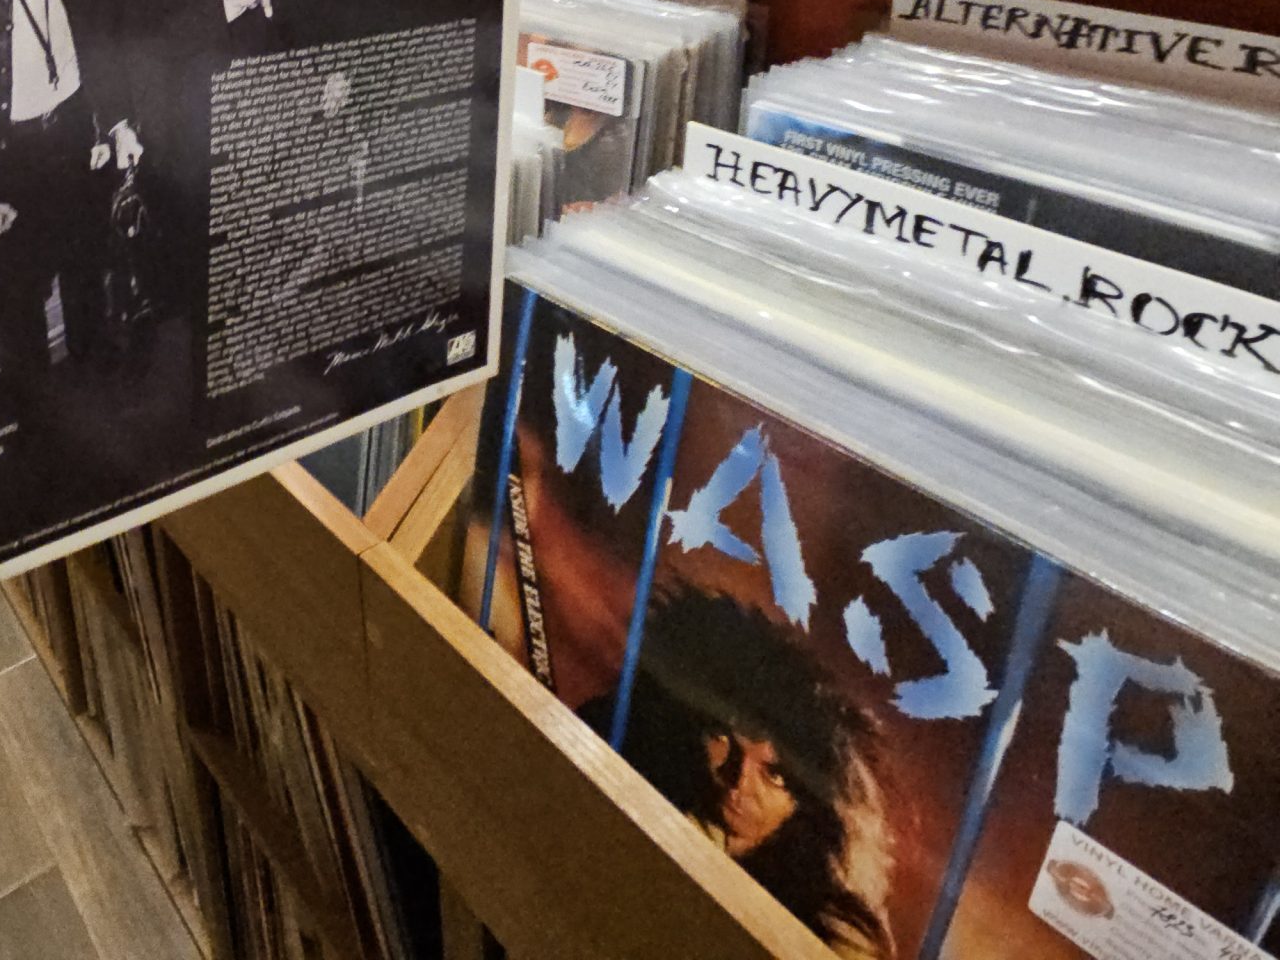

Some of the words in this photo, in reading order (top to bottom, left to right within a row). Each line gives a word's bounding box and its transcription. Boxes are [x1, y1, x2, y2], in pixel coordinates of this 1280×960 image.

[782, 129, 824, 155] FIRST
[826, 141, 868, 166] VINYL
[870, 154, 953, 195] PRESSING
[952, 181, 1001, 208] EVER
[517, 542, 538, 581] THE
[1071, 833, 1128, 879] VINYL
